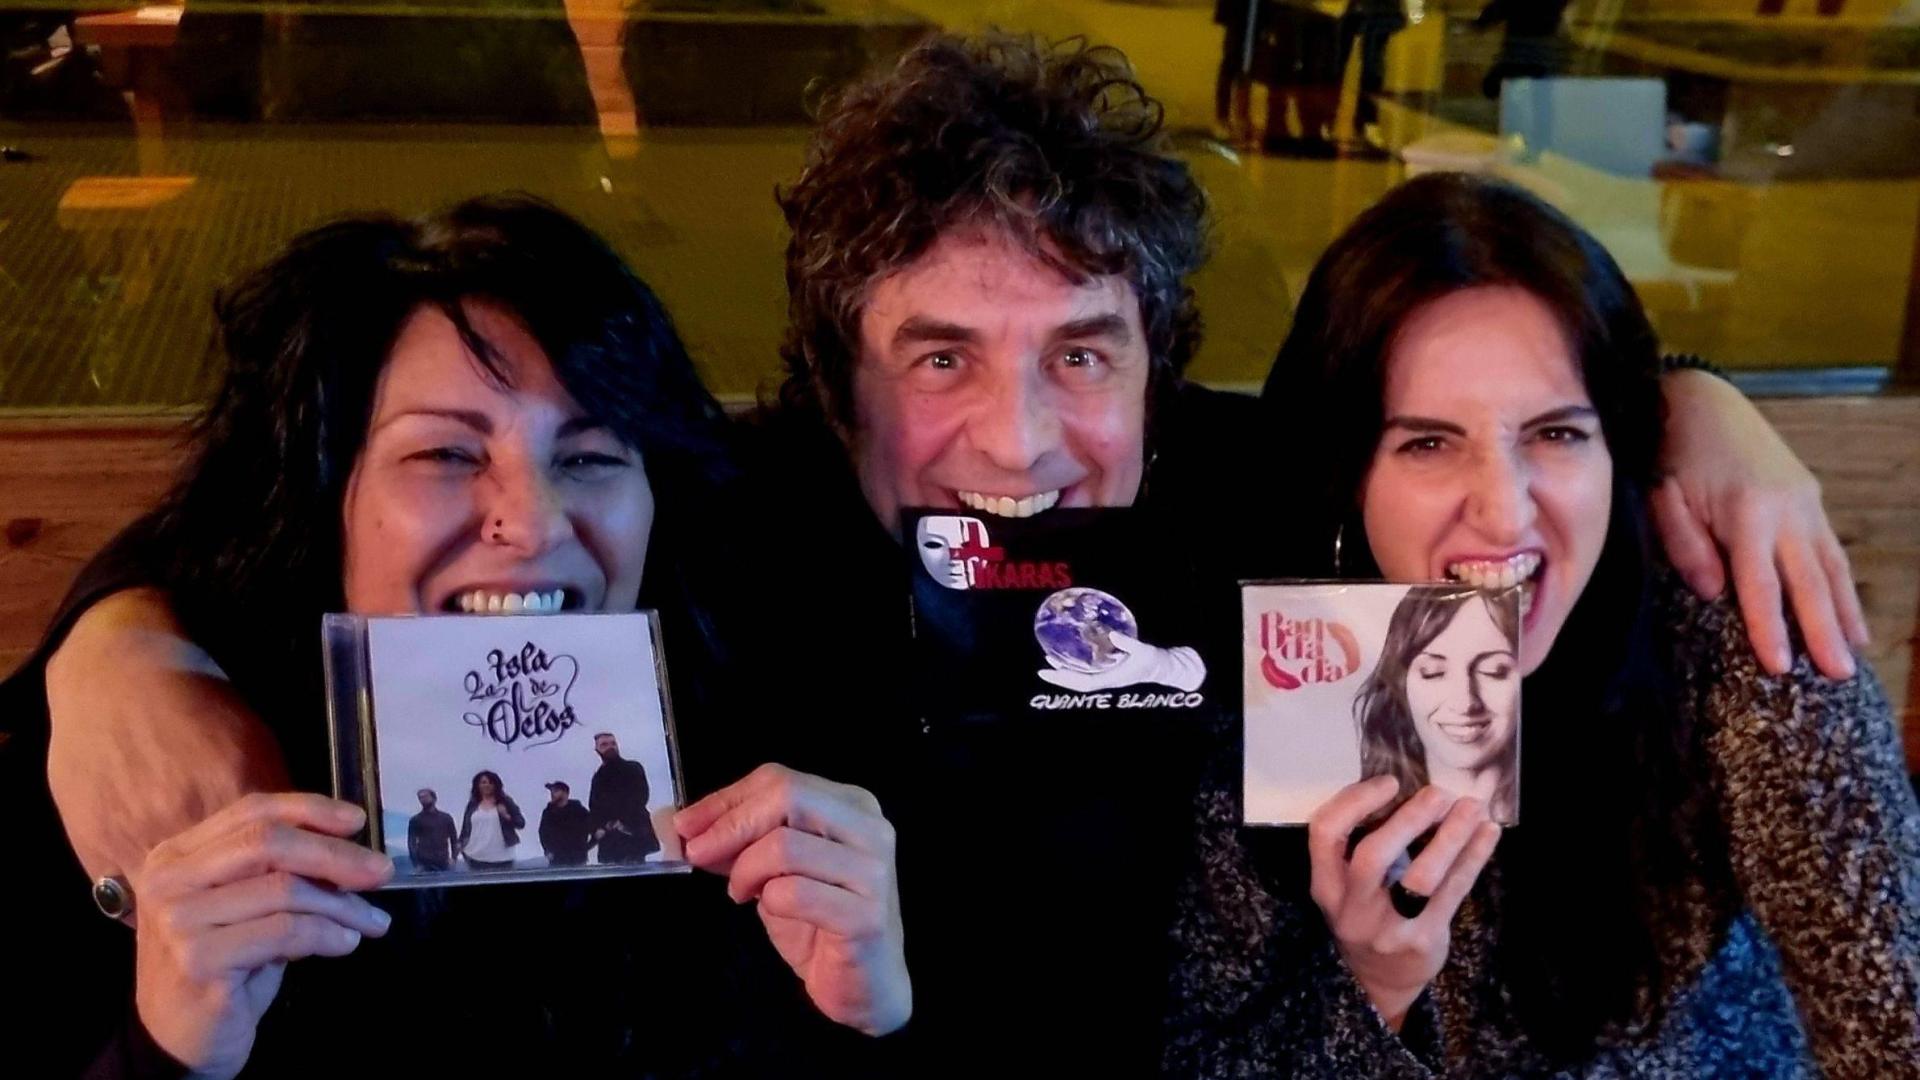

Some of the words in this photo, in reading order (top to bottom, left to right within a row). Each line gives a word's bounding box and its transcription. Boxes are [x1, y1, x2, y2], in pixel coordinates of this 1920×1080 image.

[487, 641, 552, 684] Isla
[529, 677, 560, 697] de
[1030, 694, 1112, 709] GUANTE
[1116, 693, 1204, 709] BLANCO
